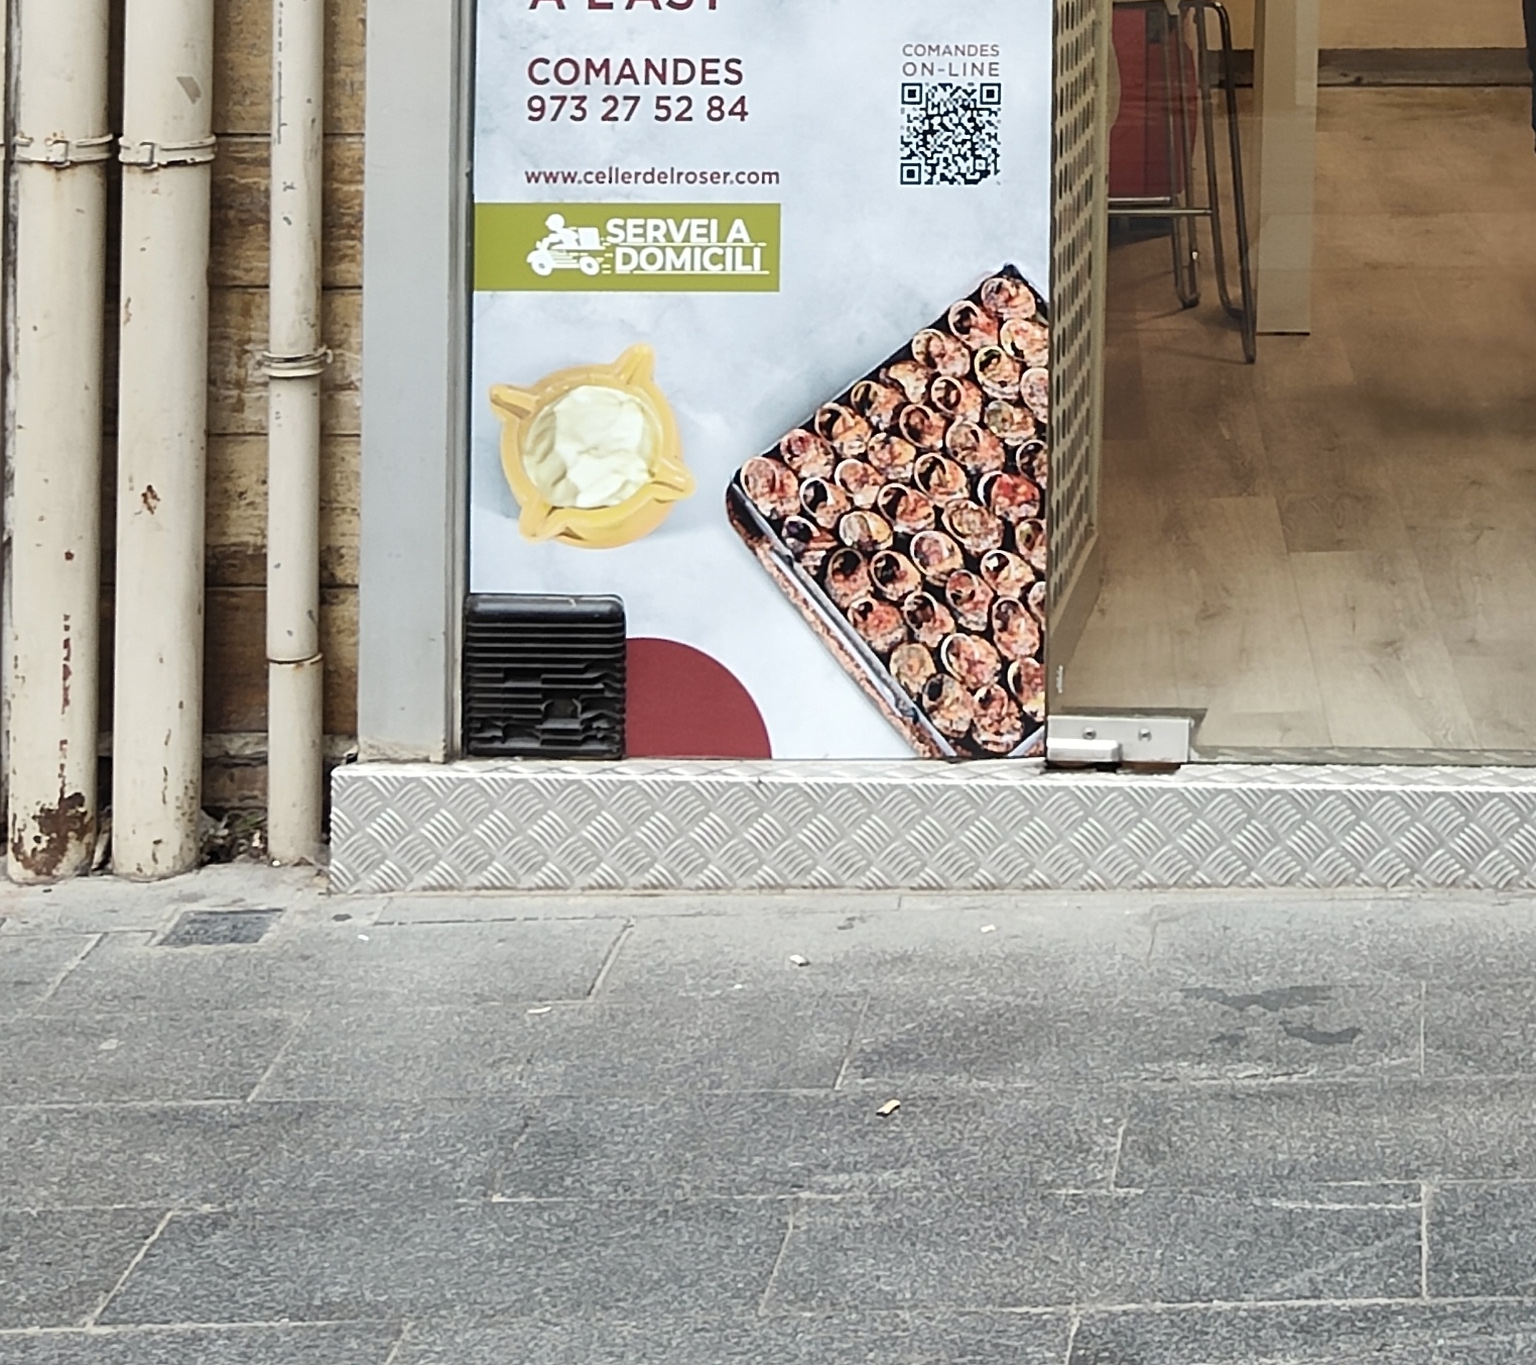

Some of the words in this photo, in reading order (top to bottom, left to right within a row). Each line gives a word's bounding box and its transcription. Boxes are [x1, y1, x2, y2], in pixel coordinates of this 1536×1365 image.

[901, 43, 1000, 58] COMANDES
[527, 57, 745, 87] COMANDES
[901, 62, 1000, 78] ON-LINE
[526, 95, 588, 123] 973
[601, 95, 640, 123] 27
[654, 95, 694, 123] 52
[706, 95, 750, 123] 84
[524, 165, 781, 187] www.cellerdelroser.com
[606, 218, 719, 245] SERVEI
[722, 218, 751, 245] A
[614, 245, 762, 274] DOMICILI
